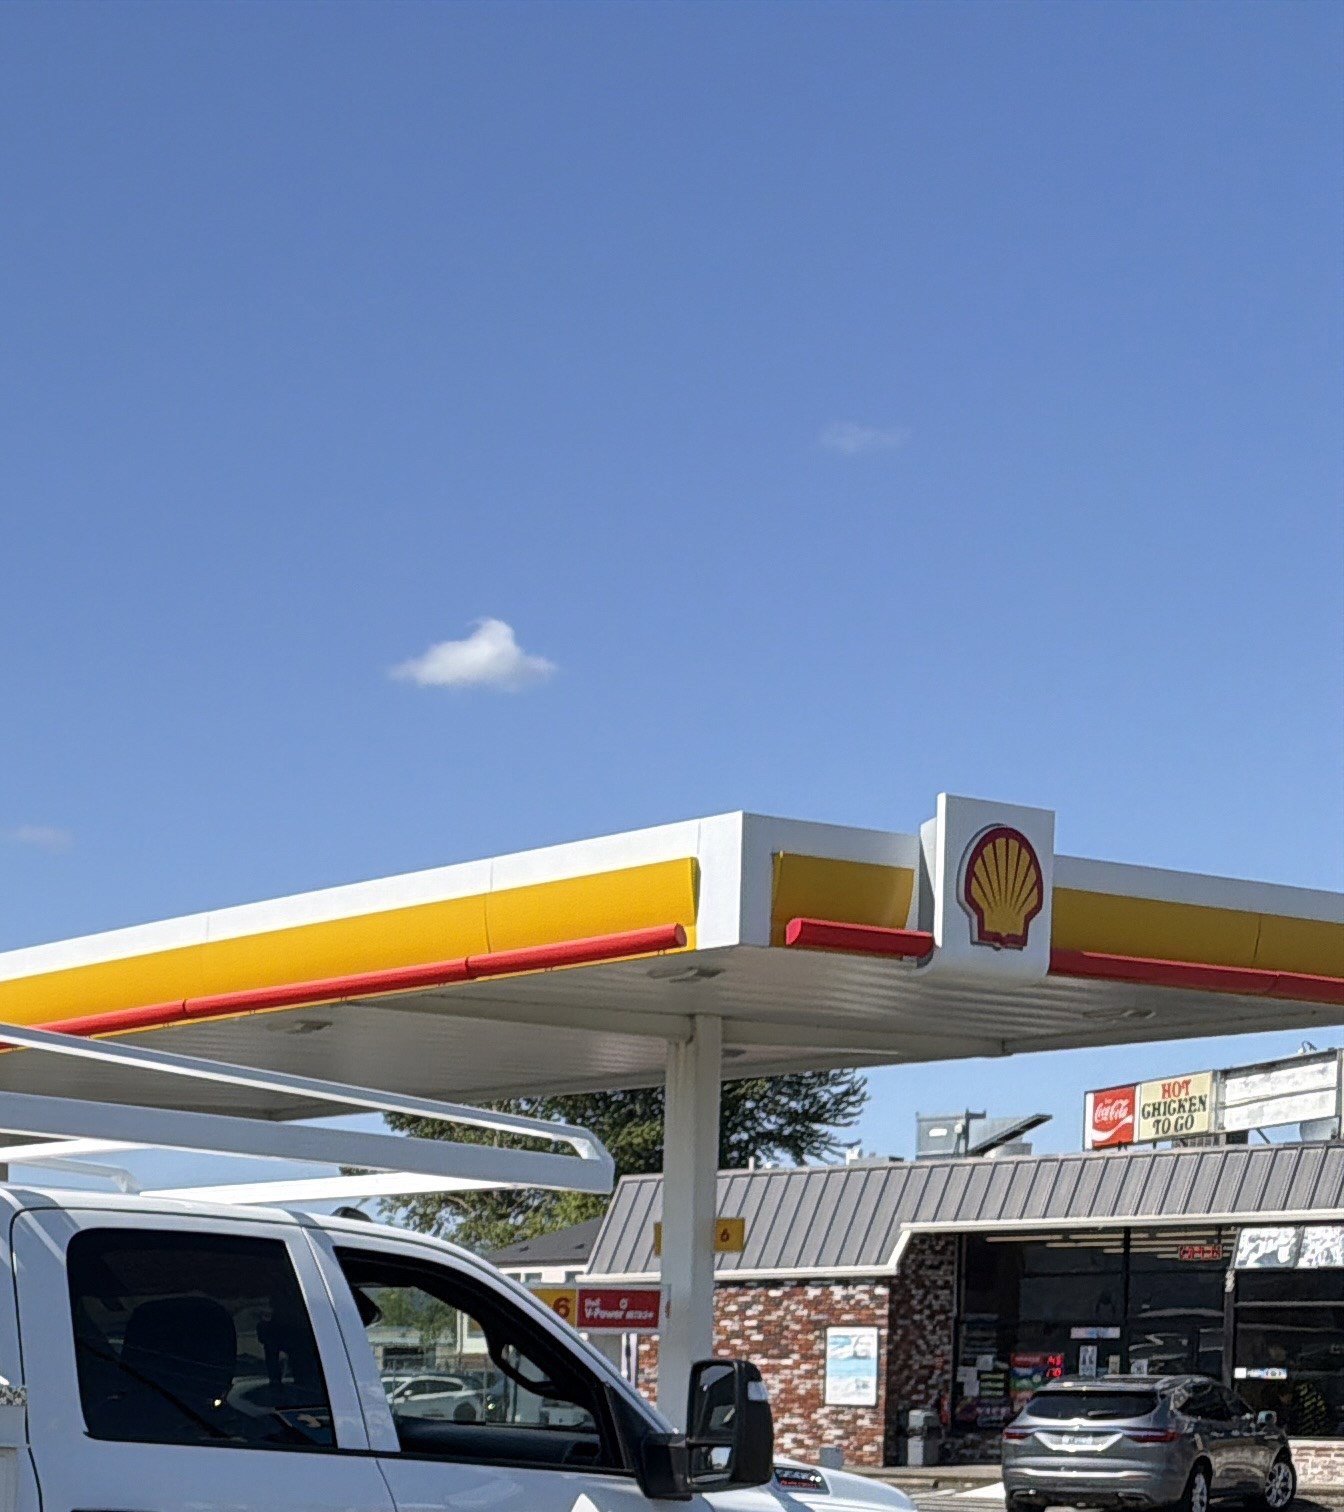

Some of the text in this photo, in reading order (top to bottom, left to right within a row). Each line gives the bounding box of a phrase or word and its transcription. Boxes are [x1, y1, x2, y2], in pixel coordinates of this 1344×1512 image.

[1161, 1079, 1192, 1099] HOT
[1141, 1094, 1208, 1120] CHICKEN
[1152, 1114, 1195, 1135] TO GO
[552, 1297, 571, 1319] 6
